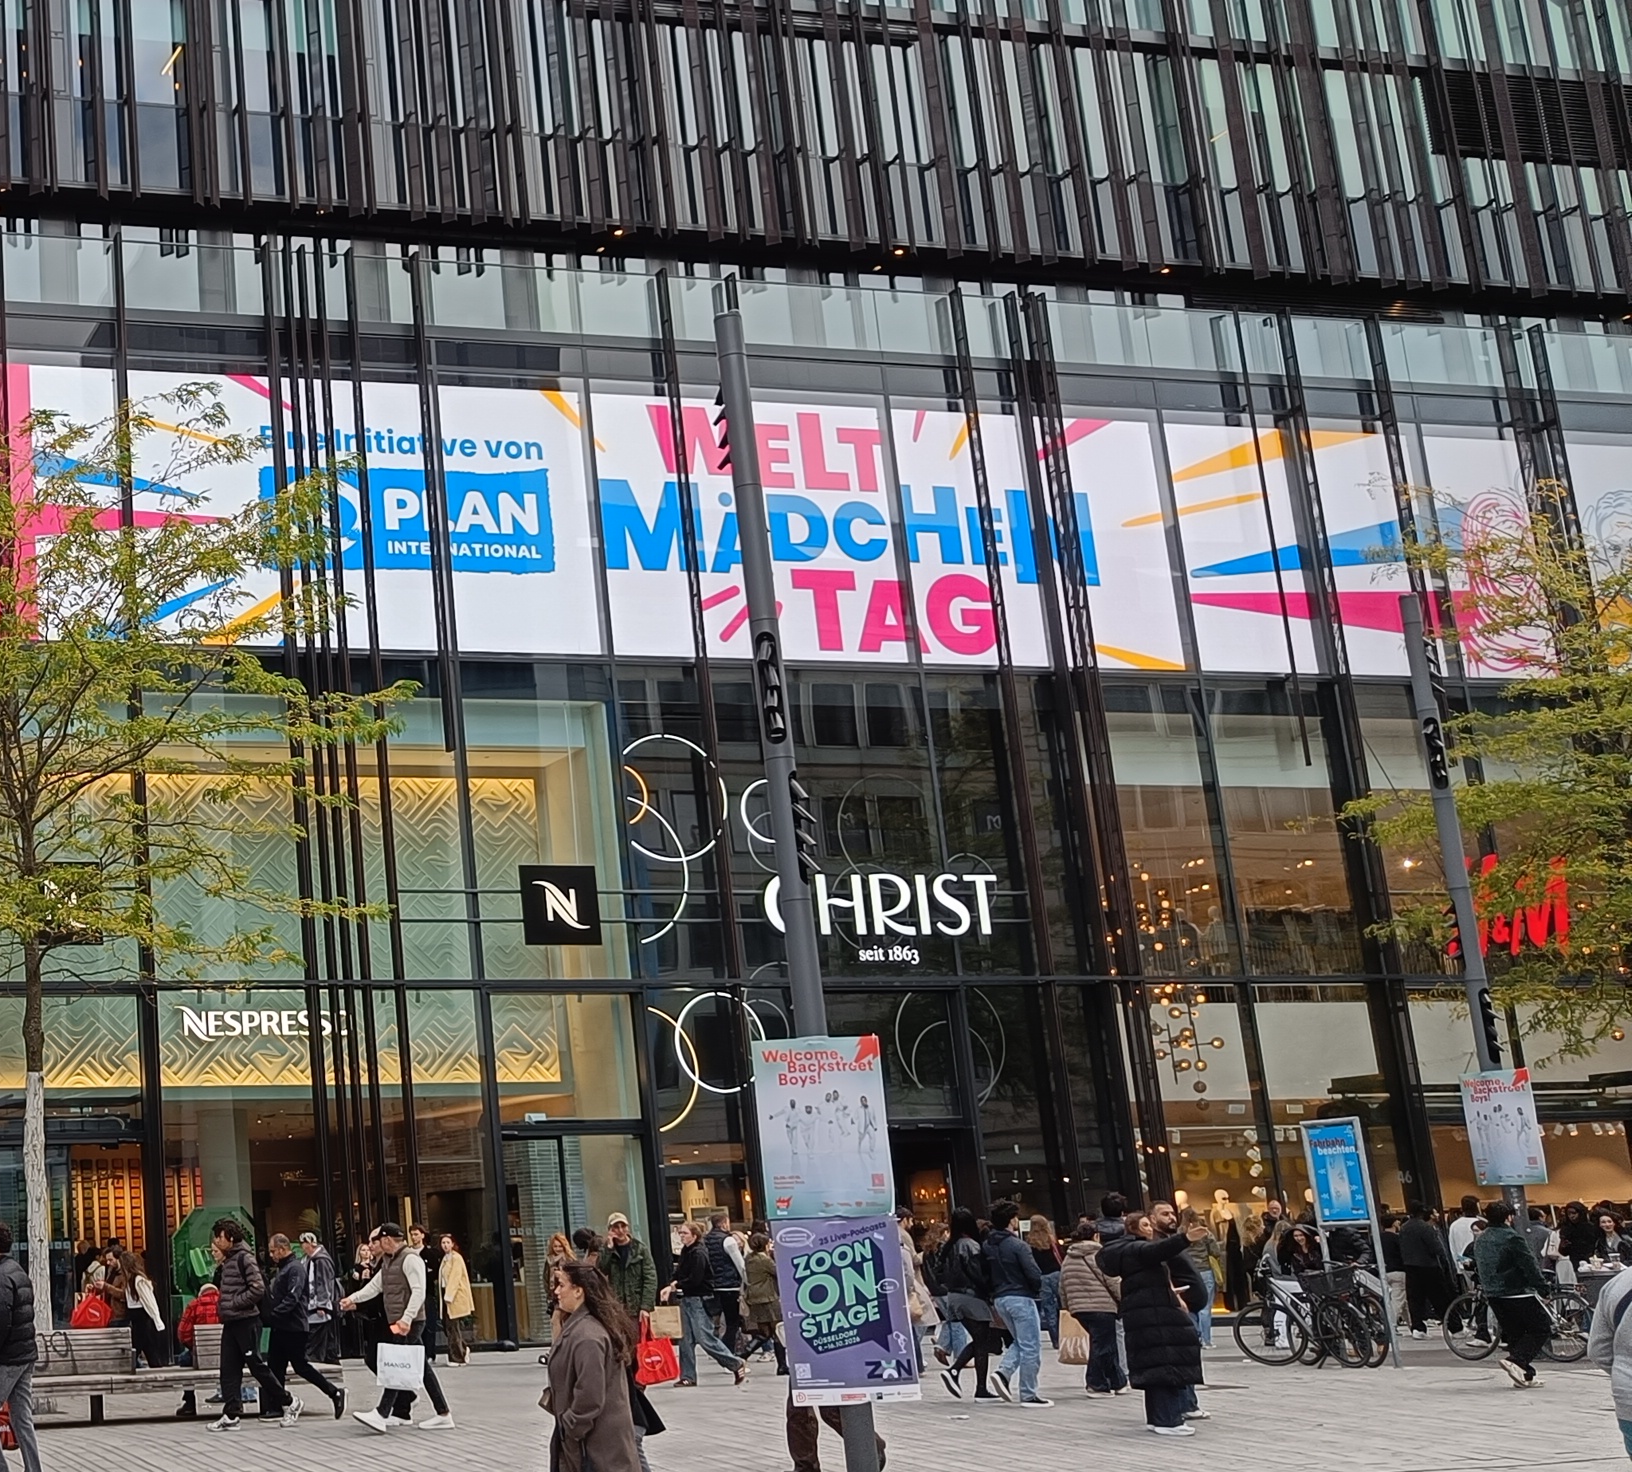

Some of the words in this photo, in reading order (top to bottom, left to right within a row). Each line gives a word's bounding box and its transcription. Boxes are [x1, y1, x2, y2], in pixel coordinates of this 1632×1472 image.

[260, 425, 327, 451] Ene
[335, 427, 477, 458] Initiatve
[484, 439, 544, 460] von
[646, 404, 883, 492] WELT
[387, 540, 542, 559] INTENATIONAL
[790, 569, 1000, 656] TAG
[859, 946, 885, 962] seit
[887, 945, 920, 965] 1863
[762, 1050, 844, 1063] Welcome,
[787, 1058, 874, 1074] Backstreet
[779, 1072, 822, 1087] Boys!
[1398, 1170, 1412, 1184] 46
[818, 1237, 829, 1246] 25
[830, 1222, 887, 1243] Live-Podcasts
[792, 1238, 873, 1279] ZOON
[797, 1260, 878, 1315] ON
[801, 1300, 881, 1339] STAGE
[813, 1329, 858, 1346] DÜSSELDORF
